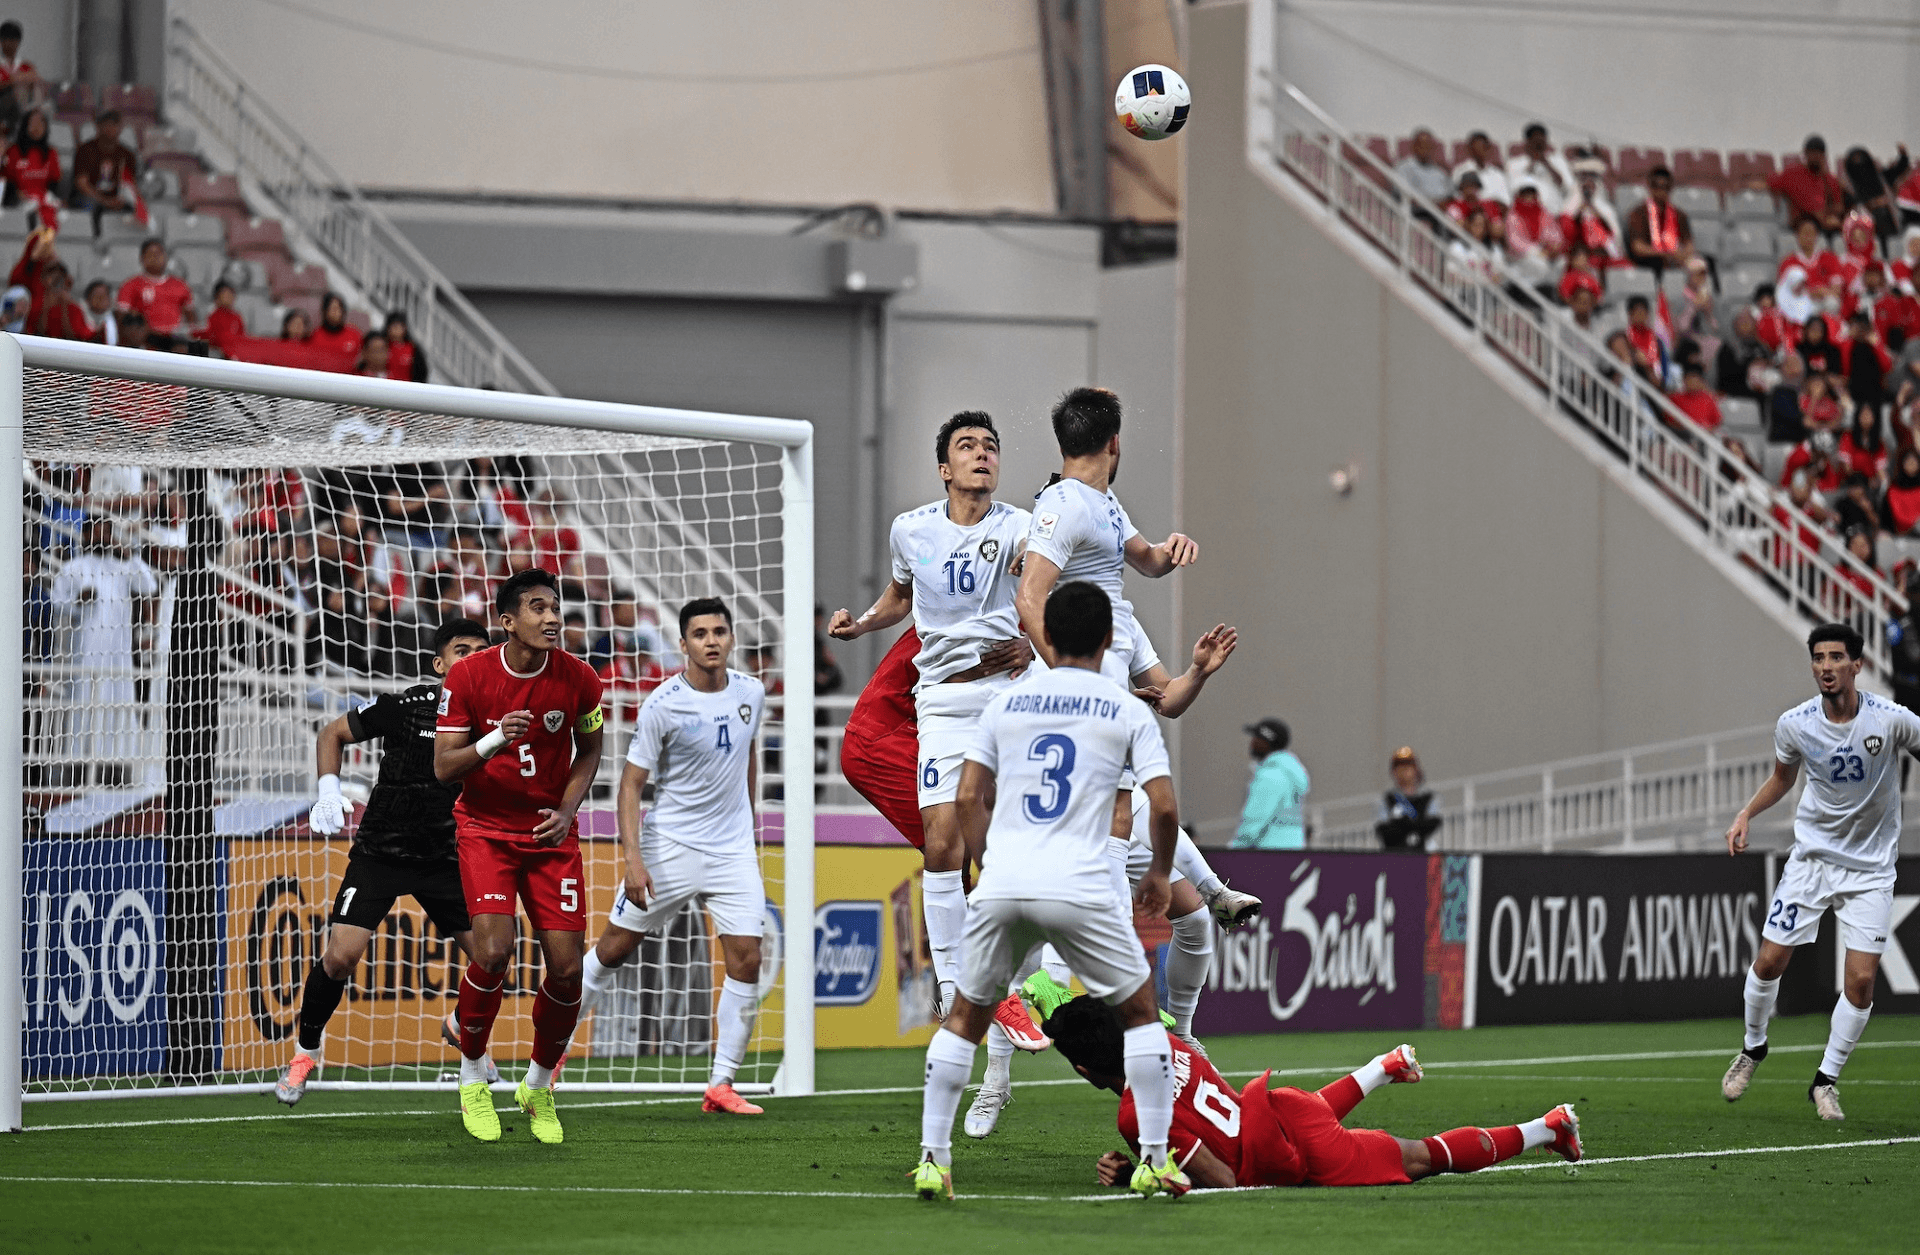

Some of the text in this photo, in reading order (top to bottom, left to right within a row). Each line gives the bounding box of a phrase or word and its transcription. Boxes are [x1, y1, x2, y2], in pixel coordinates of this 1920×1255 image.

[982, 542, 998, 553] UFA
[942, 560, 975, 595] 16
[1004, 694, 1121, 721] ABDIRAKHMATOV
[716, 724, 732, 754] 4
[1866, 738, 1881, 748] UFA
[518, 743, 537, 777] 5
[1829, 755, 1865, 783] 23
[1022, 733, 1076, 825] 3
[340, 887, 357, 916] 1
[560, 878, 578, 912] 5
[1767, 899, 1799, 931] 23
[1488, 891, 1761, 997] QATAR AIRWAYS
